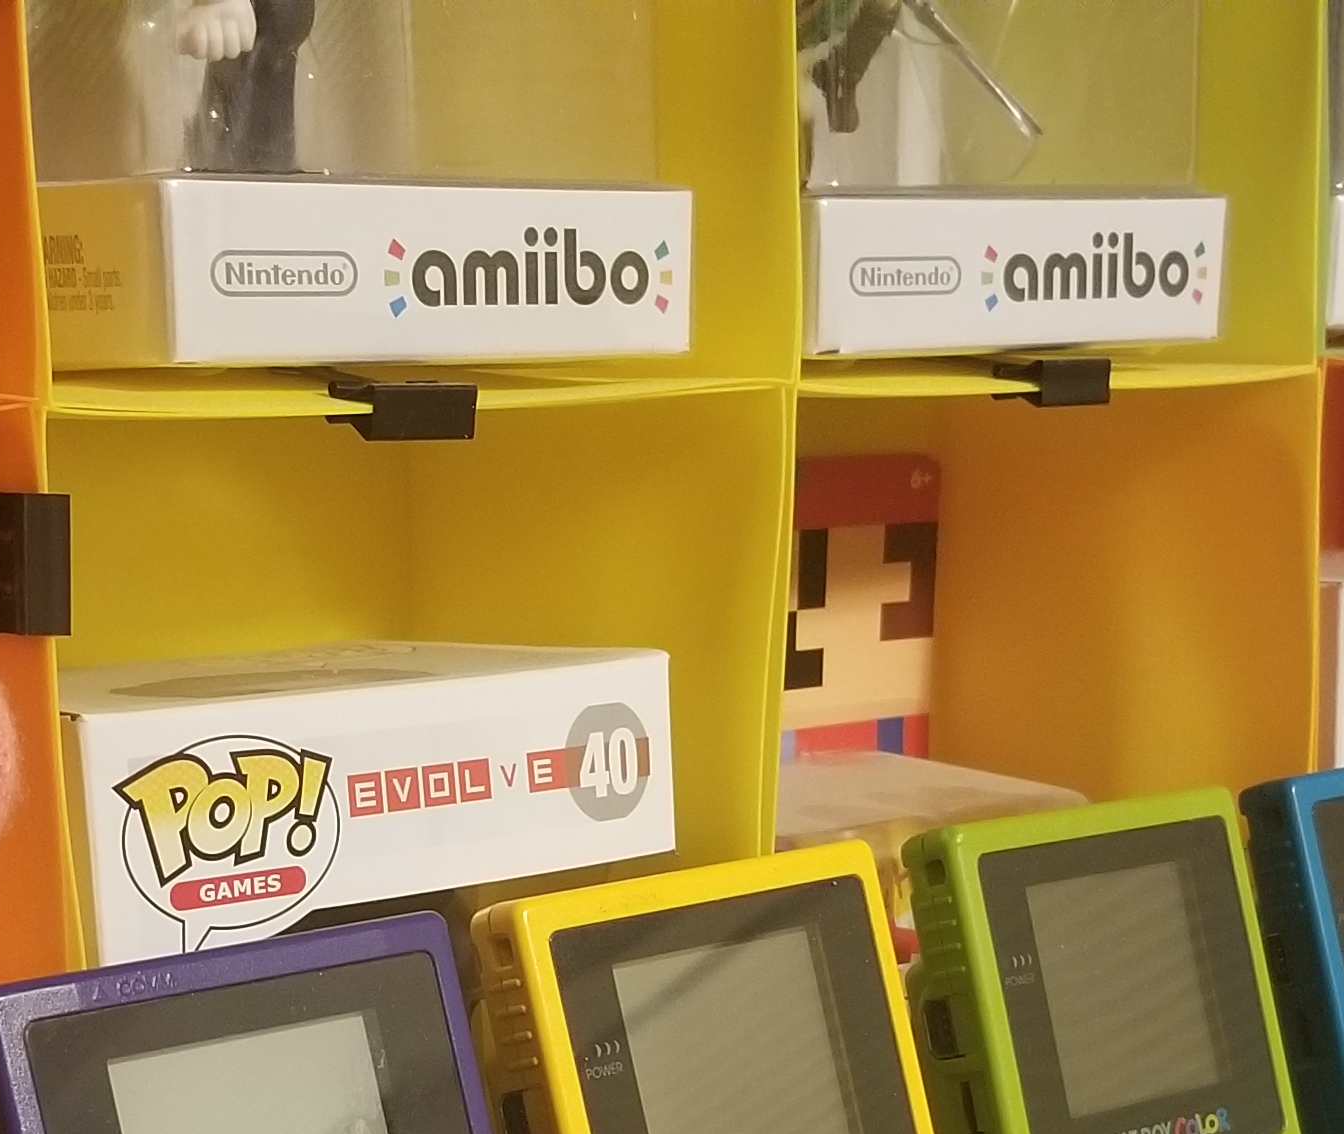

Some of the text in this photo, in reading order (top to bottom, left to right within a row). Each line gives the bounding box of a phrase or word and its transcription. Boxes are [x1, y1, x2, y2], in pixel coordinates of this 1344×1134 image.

[224, 261, 349, 288] Nintendo
[411, 226, 650, 307] amiibo
[859, 266, 953, 288] Nintendo
[1003, 231, 1190, 303] amiibo
[348, 756, 560, 817] EVOLVE
[579, 726, 639, 799] 40
[112, 748, 332, 888] POP!
[199, 874, 282, 903] GAMES
[585, 1060, 624, 1082] POWER
